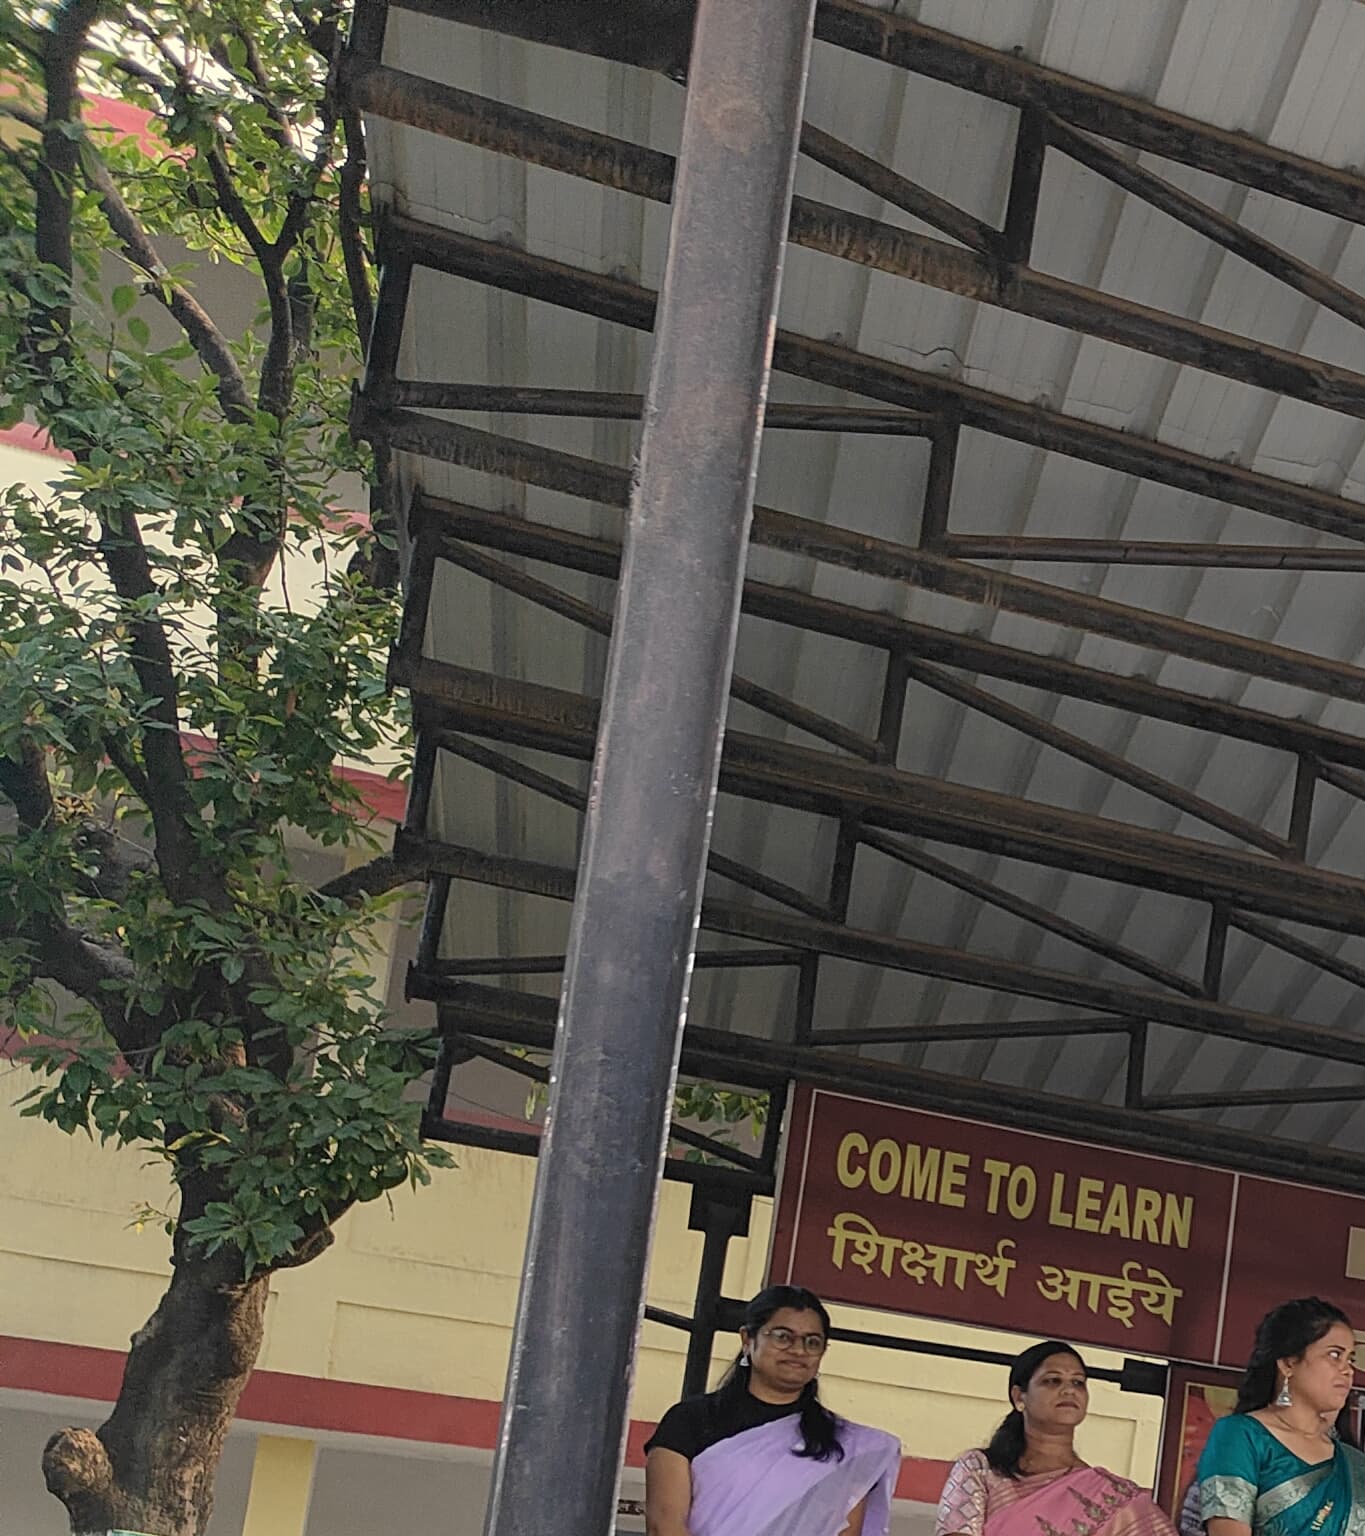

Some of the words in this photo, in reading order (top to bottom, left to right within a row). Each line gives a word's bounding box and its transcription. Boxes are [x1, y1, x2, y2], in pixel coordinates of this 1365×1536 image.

[836, 1131, 970, 1208] COME
[983, 1157, 1039, 1221] TO
[1047, 1171, 1193, 1249] LEARN
[827, 1212, 1016, 1297] शिक्षार्थ
[1037, 1261, 1183, 1329] आईये
